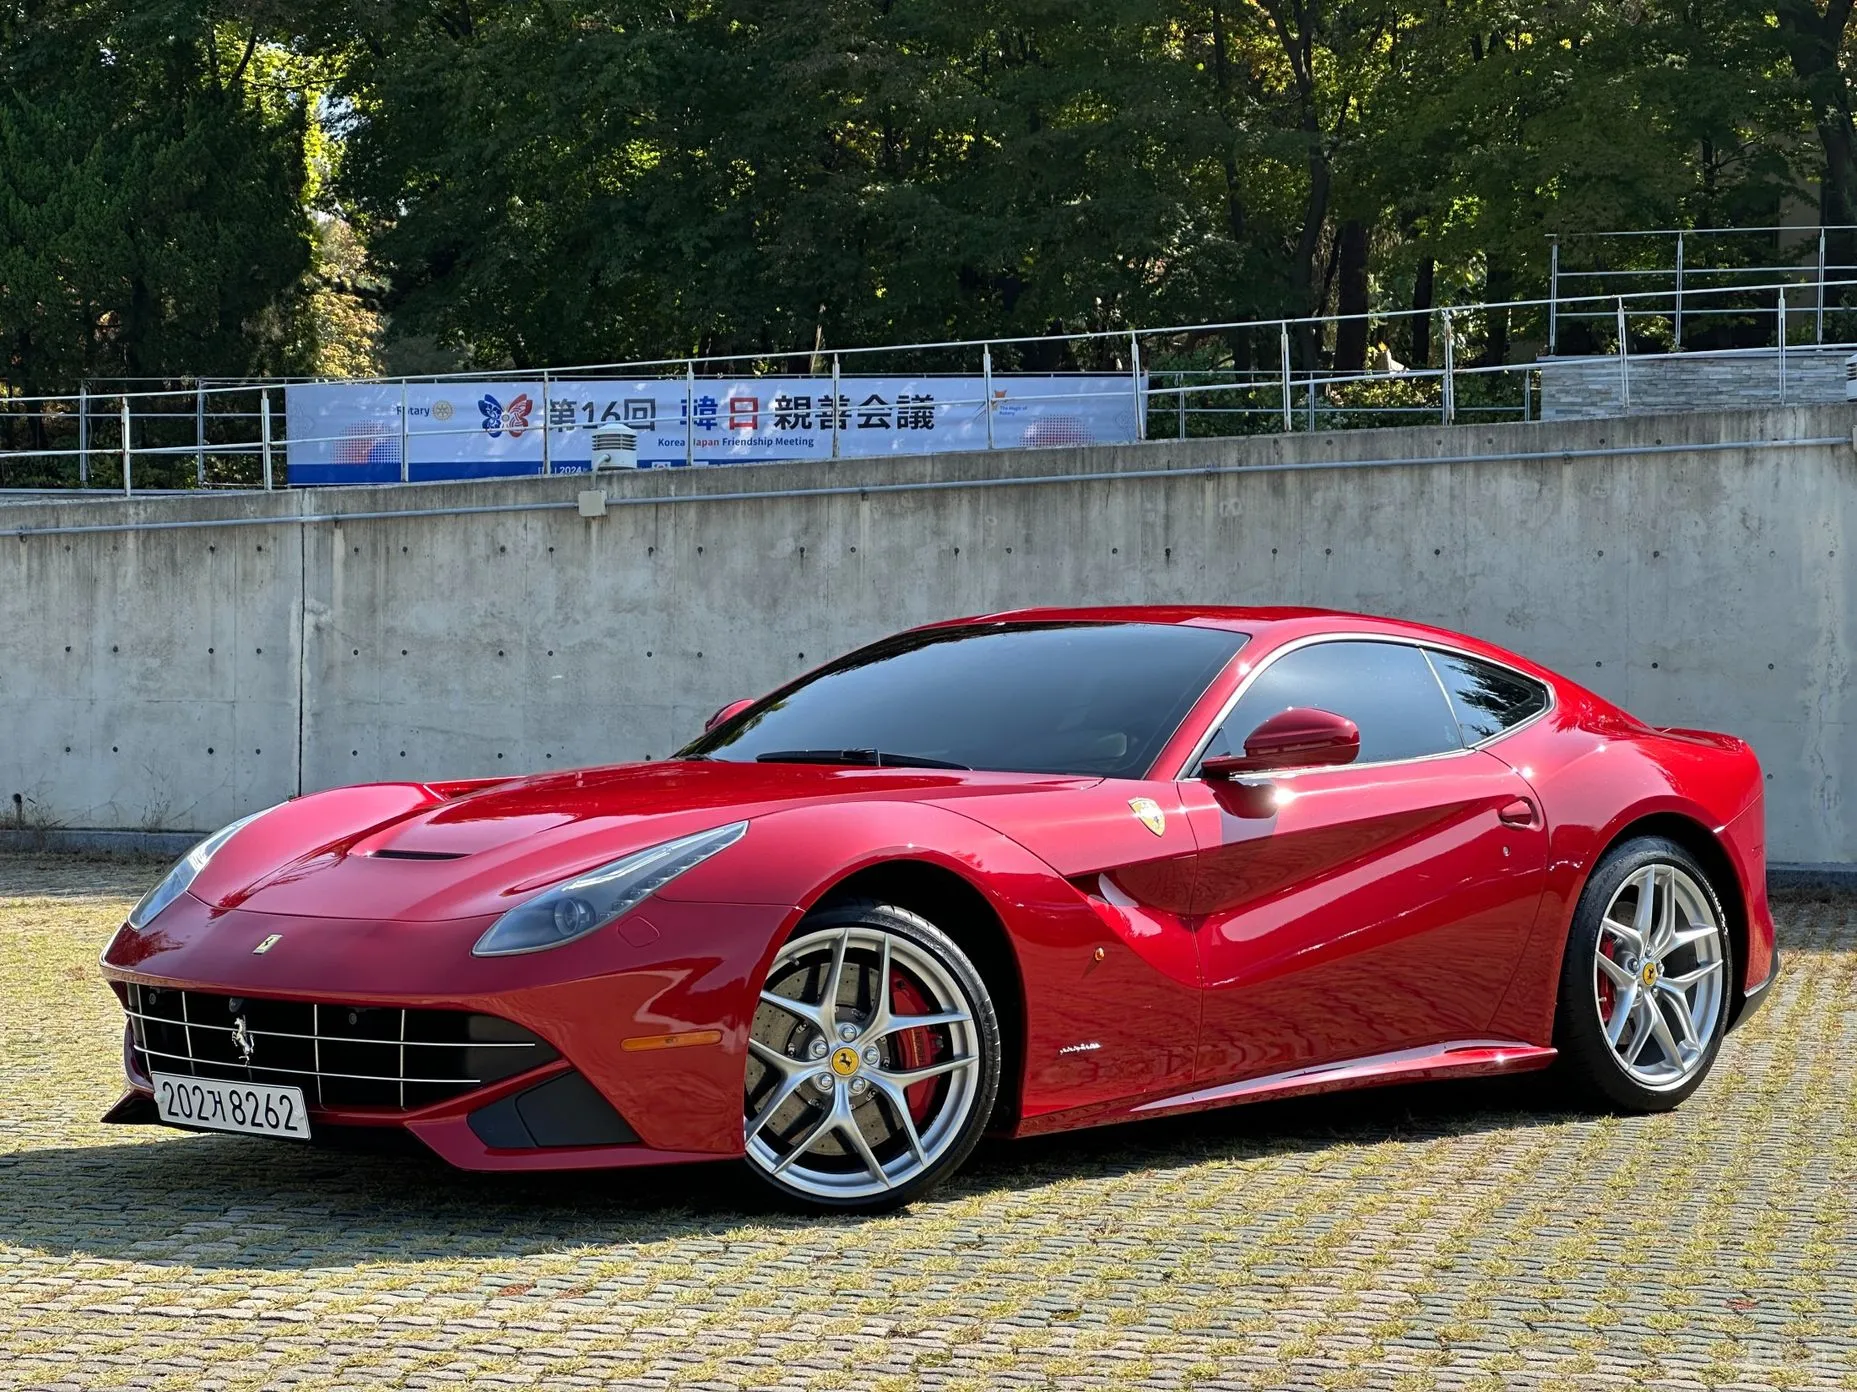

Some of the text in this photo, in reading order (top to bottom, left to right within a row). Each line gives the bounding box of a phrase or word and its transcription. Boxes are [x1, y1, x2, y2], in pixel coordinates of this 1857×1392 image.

[396, 406, 430, 417] Rtary
[658, 438, 685, 447] Korea
[722, 437, 773, 448] Friendship
[775, 436, 814, 448] Meeting
